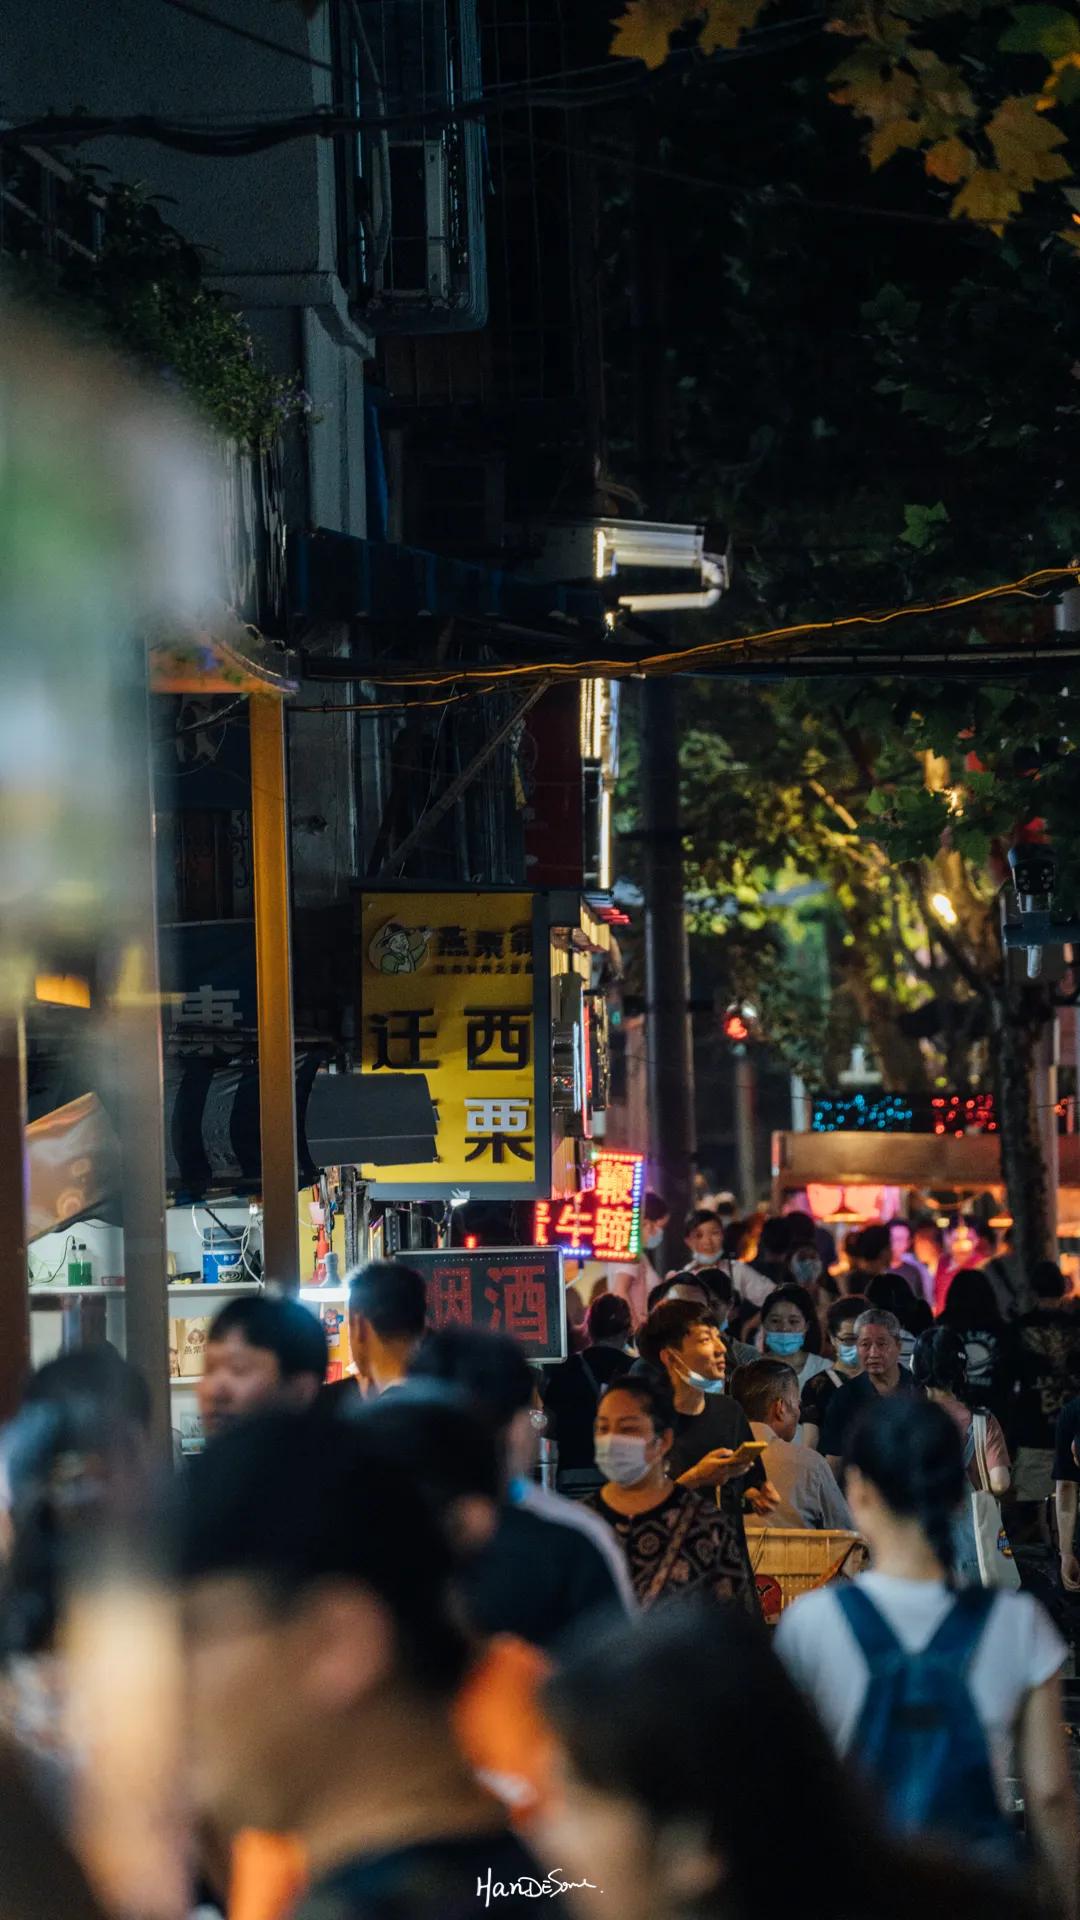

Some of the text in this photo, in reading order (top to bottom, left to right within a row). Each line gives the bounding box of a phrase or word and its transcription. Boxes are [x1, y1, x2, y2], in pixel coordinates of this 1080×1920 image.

[369, 1004, 533, 1071] 迁西
[432, 1097, 534, 1164] 栗
[425, 1265, 549, 1345] 烟酒
